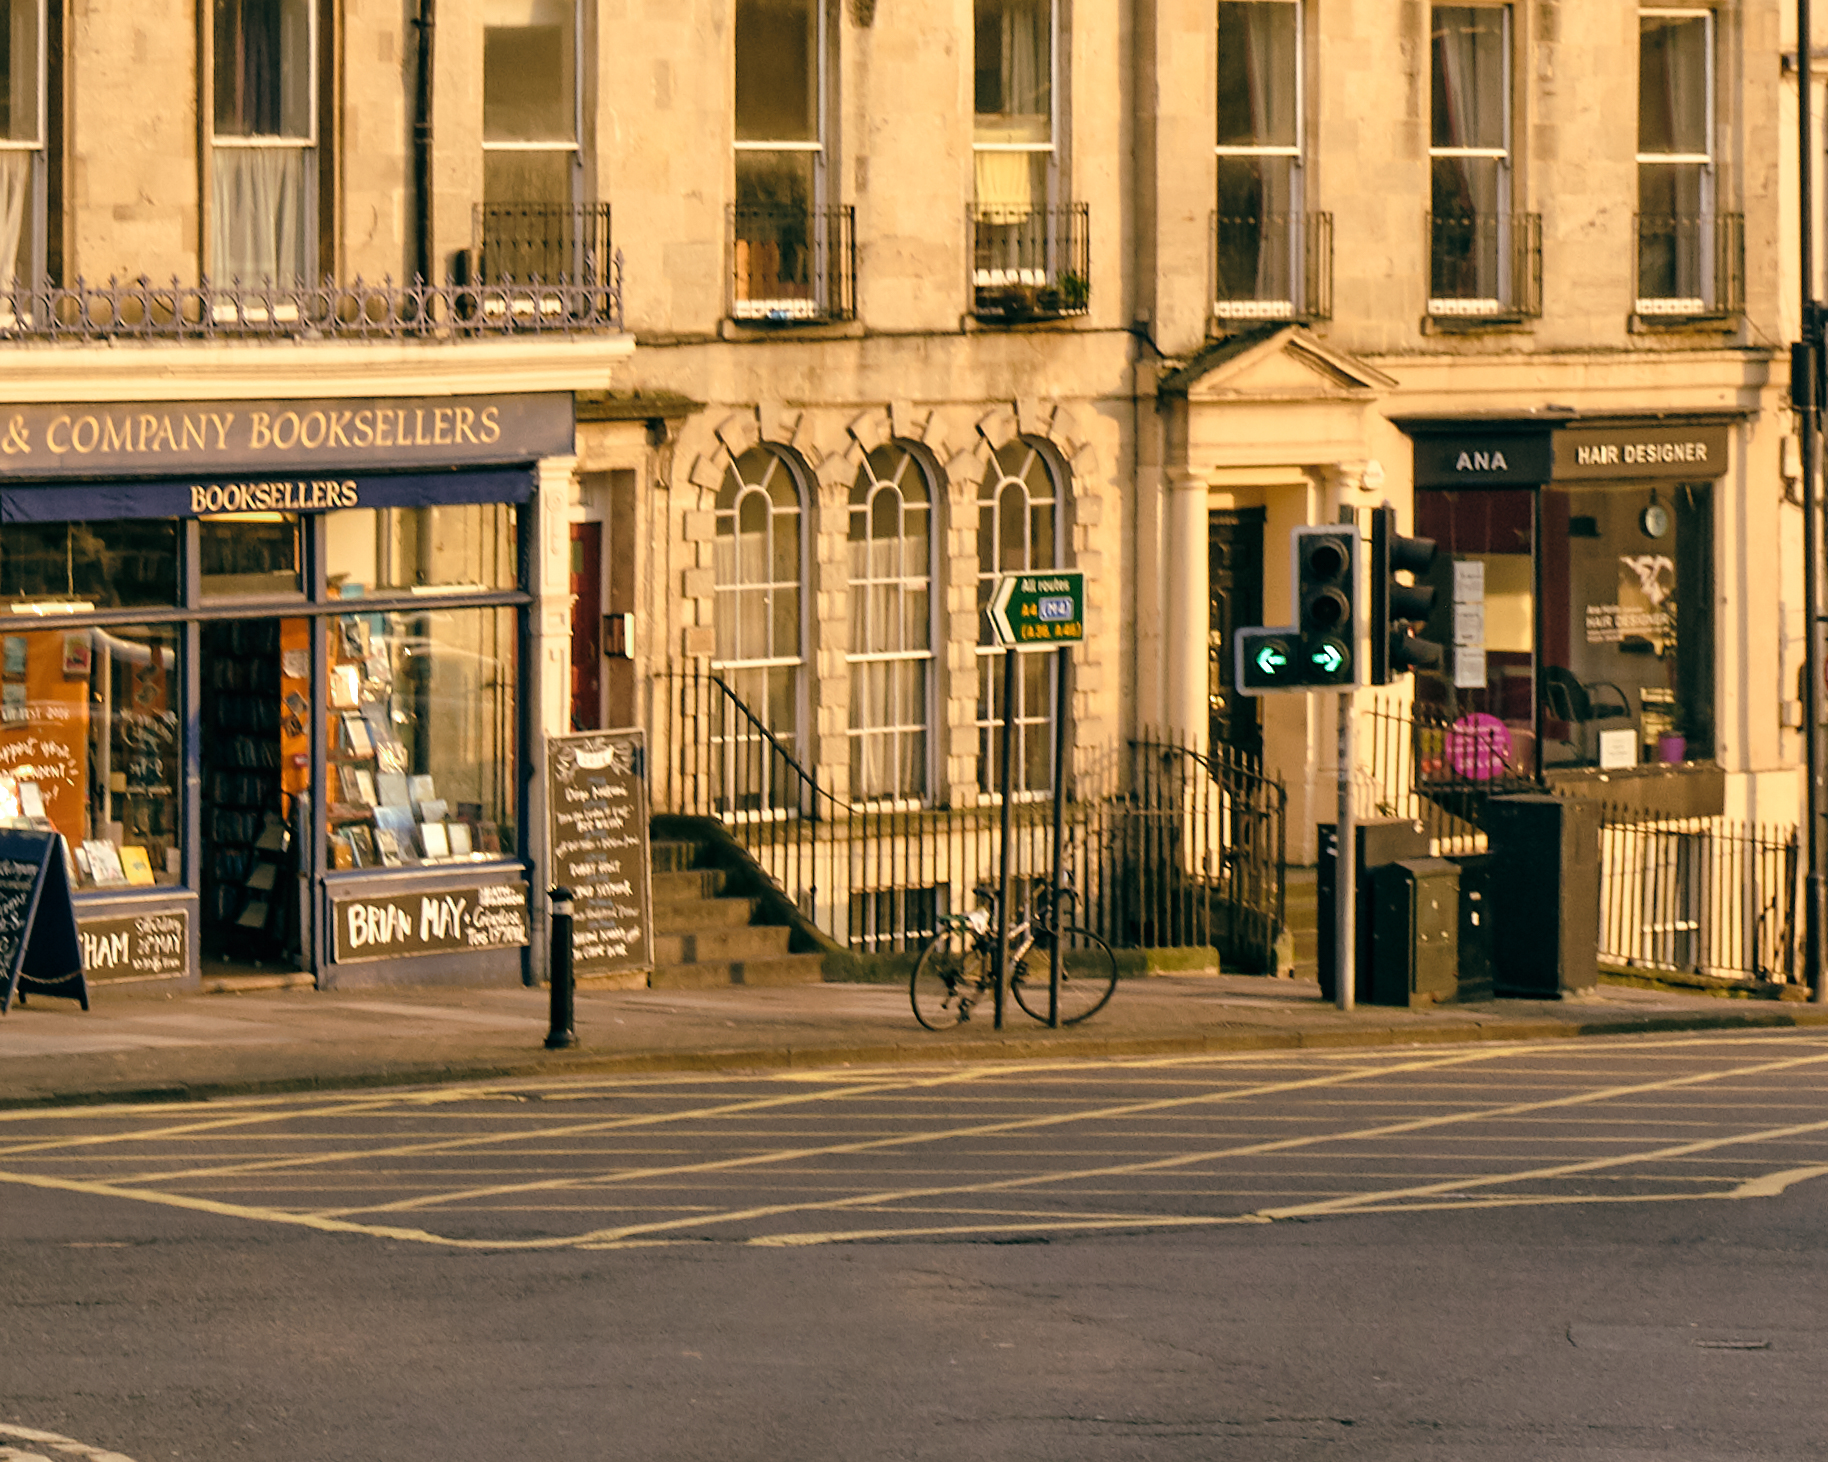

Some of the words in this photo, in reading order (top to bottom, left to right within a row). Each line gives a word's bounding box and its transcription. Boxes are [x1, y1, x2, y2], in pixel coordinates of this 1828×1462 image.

[1, 413, 31, 455] &
[46, 411, 235, 454] COMPANY
[248, 406, 501, 450] BOOKSELLERS
[1456, 451, 1508, 471] ANA
[1577, 445, 1619, 465] HAIR
[1624, 442, 1708, 464] DESIGNER
[190, 480, 358, 512] BOOKSELLERS
[1038, 577, 1070, 593] routes
[1021, 602, 1038, 617] A4
[347, 903, 412, 949] BRIAN
[420, 895, 466, 942] MAY
[79, 931, 129, 970] HAM
